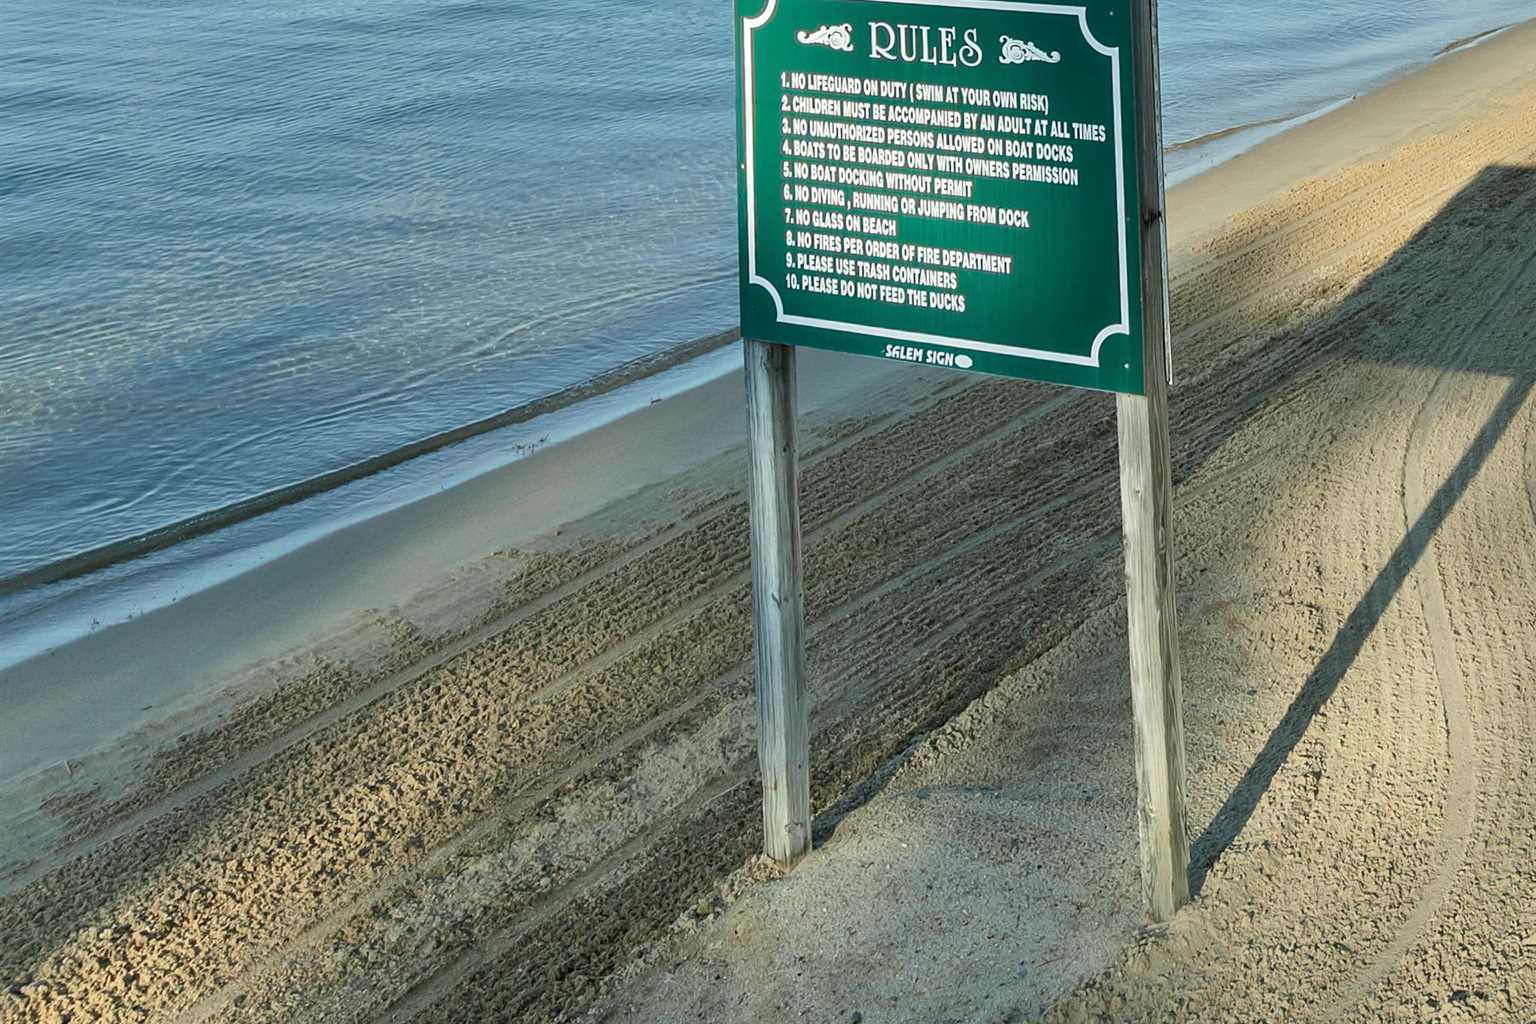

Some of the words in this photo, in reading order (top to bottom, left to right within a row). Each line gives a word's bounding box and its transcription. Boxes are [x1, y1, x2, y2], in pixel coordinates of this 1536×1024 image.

[867, 22, 983, 68] RULES
[780, 72, 790, 89] 1.
[792, 72, 806, 90] NO
[808, 74, 861, 95] LIFEGUARD
[863, 79, 878, 97] ON
[880, 80, 907, 99] DUTY
[915, 84, 944, 103] SWIM
[945, 86, 960, 104] AT
[960, 88, 992, 107] YOUR
[992, 90, 1018, 110] OWN
[1020, 93, 1049, 115] RISK)
[781, 94, 791, 112] 2.
[792, 96, 840, 117] CHILDREN
[842, 100, 871, 120] MUST
[872, 103, 886, 121] BE
[888, 104, 962, 128] ACCOMPANIED
[963, 111, 976, 130] BY
[980, 113, 996, 132] AN
[996, 114, 1032, 135] ADULT
[1034, 118, 1048, 137] AT
[1050, 119, 1070, 139] ALL
[1072, 121, 1106, 142] TIMES
[782, 117, 792, 135] 3.
[792, 118, 808, 137] NO
[809, 120, 886, 144] UNAUTHORIZED
[887, 127, 934, 149] PERSONS
[936, 132, 984, 154] ALLOWED
[987, 137, 1002, 156] ON
[1005, 139, 1034, 159] BOAT
[1036, 142, 1074, 163] DOCKS
[782, 139, 792, 156] 4.
[794, 140, 826, 160] BOATS
[826, 143, 841, 161] TO
[842, 145, 856, 163] BE
[858, 147, 905, 168] BOARDED
[906, 152, 934, 171] ONLY
[936, 155, 963, 174] WITH
[966, 158, 1010, 179] OWNERS
[1012, 162, 1078, 186] PERMISSION
[782, 161, 792, 179] 5.
[794, 163, 809, 181] NO
[810, 164, 838, 183] BOAT
[838, 167, 884, 188] DOCKING
[886, 172, 932, 193] WITHOUT
[934, 177, 972, 198] PERMIT
[783, 184, 794, 201] 6.
[794, 185, 809, 203] NO
[811, 187, 845, 207] DIVING
[852, 192, 898, 213] RUNNING
[900, 197, 916, 215] OR
[917, 199, 964, 220] JUMPING
[966, 204, 996, 224] FROM
[998, 207, 1030, 228] DOCK
[784, 208, 794, 225] 7.
[796, 209, 810, 227] NO
[812, 211, 844, 231] GLASS
[846, 215, 861, 233] ON
[862, 216, 897, 237] BEACH
[786, 230, 796, 247] 8.
[796, 231, 812, 249] NO
[814, 233, 842, 253] FIRES
[844, 237, 864, 256] PER
[865, 240, 900, 260] ORDER
[902, 244, 916, 262] OF
[917, 246, 941, 265] FIRE
[942, 249, 1012, 274] DEPARTMENT
[786, 252, 796, 269] 9.
[797, 253, 834, 274] PLEASE
[836, 258, 856, 276] USE
[857, 260, 890, 281] TRASH
[892, 265, 958, 290] CONTAINERS
[785, 273, 800, 291] 10.
[802, 275, 839, 296] PLEASE
[840, 280, 856, 298] DO
[856, 282, 878, 301] NOT
[880, 285, 905, 305] FEED
[907, 288, 928, 308] THE
[930, 291, 966, 312] DUCKS
[885, 344, 923, 362] SALEM
[926, 350, 954, 367] SIGN
